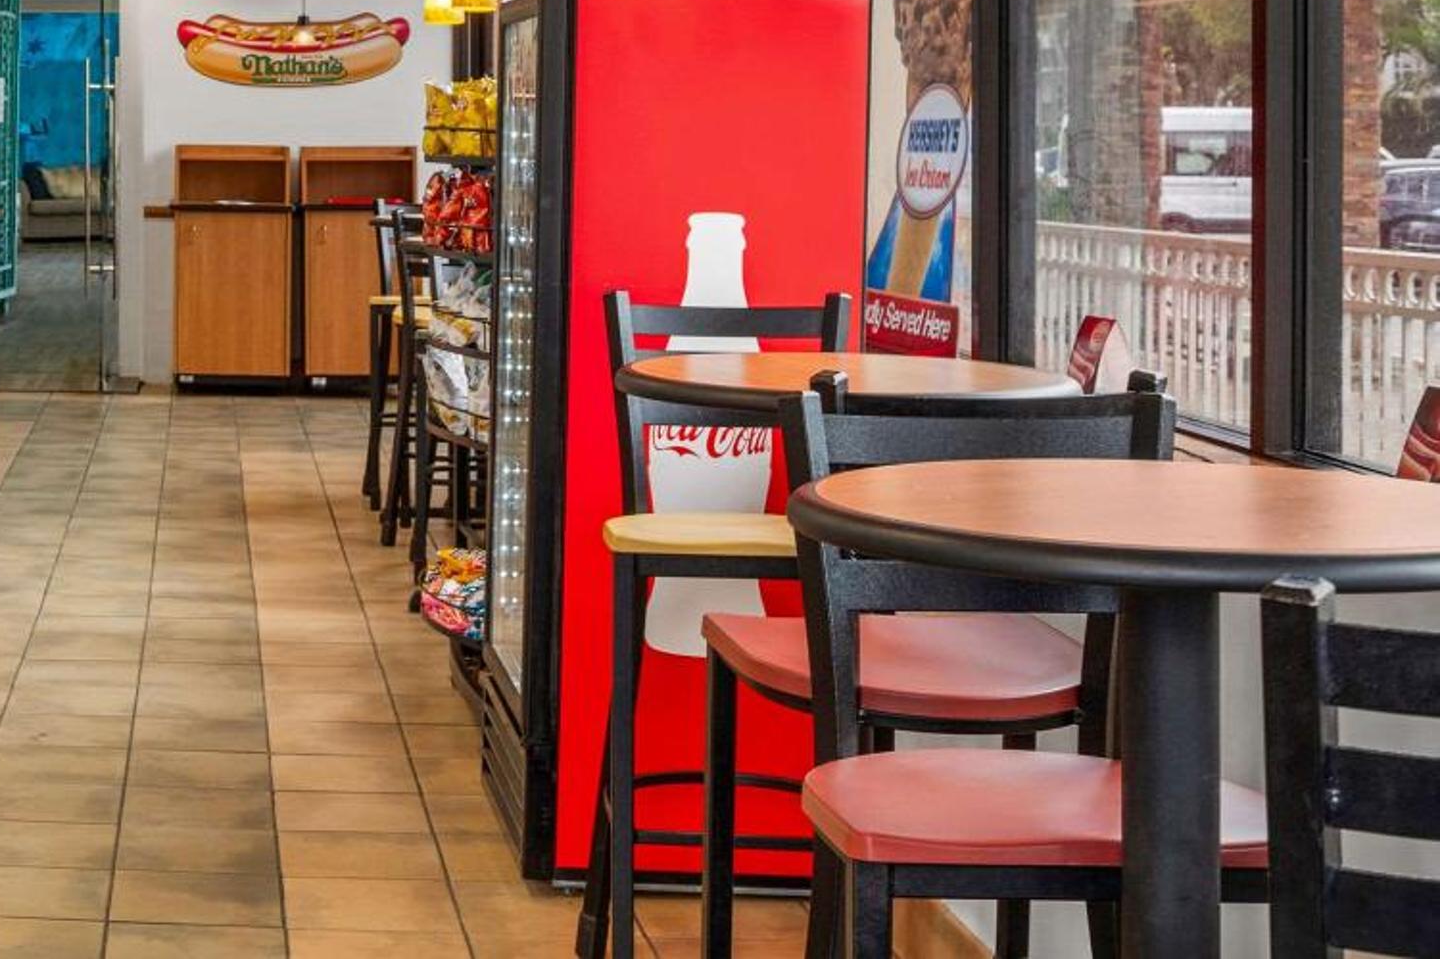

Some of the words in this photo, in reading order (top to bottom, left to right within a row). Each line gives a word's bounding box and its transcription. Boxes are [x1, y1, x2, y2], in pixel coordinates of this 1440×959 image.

[241, 53, 348, 77] Nathan's
[906, 119, 960, 154] HERSHEY'S
[904, 159, 918, 189] Ice
[918, 158, 952, 190] Cream
[883, 300, 925, 336] Served
[922, 309, 952, 343] Here
